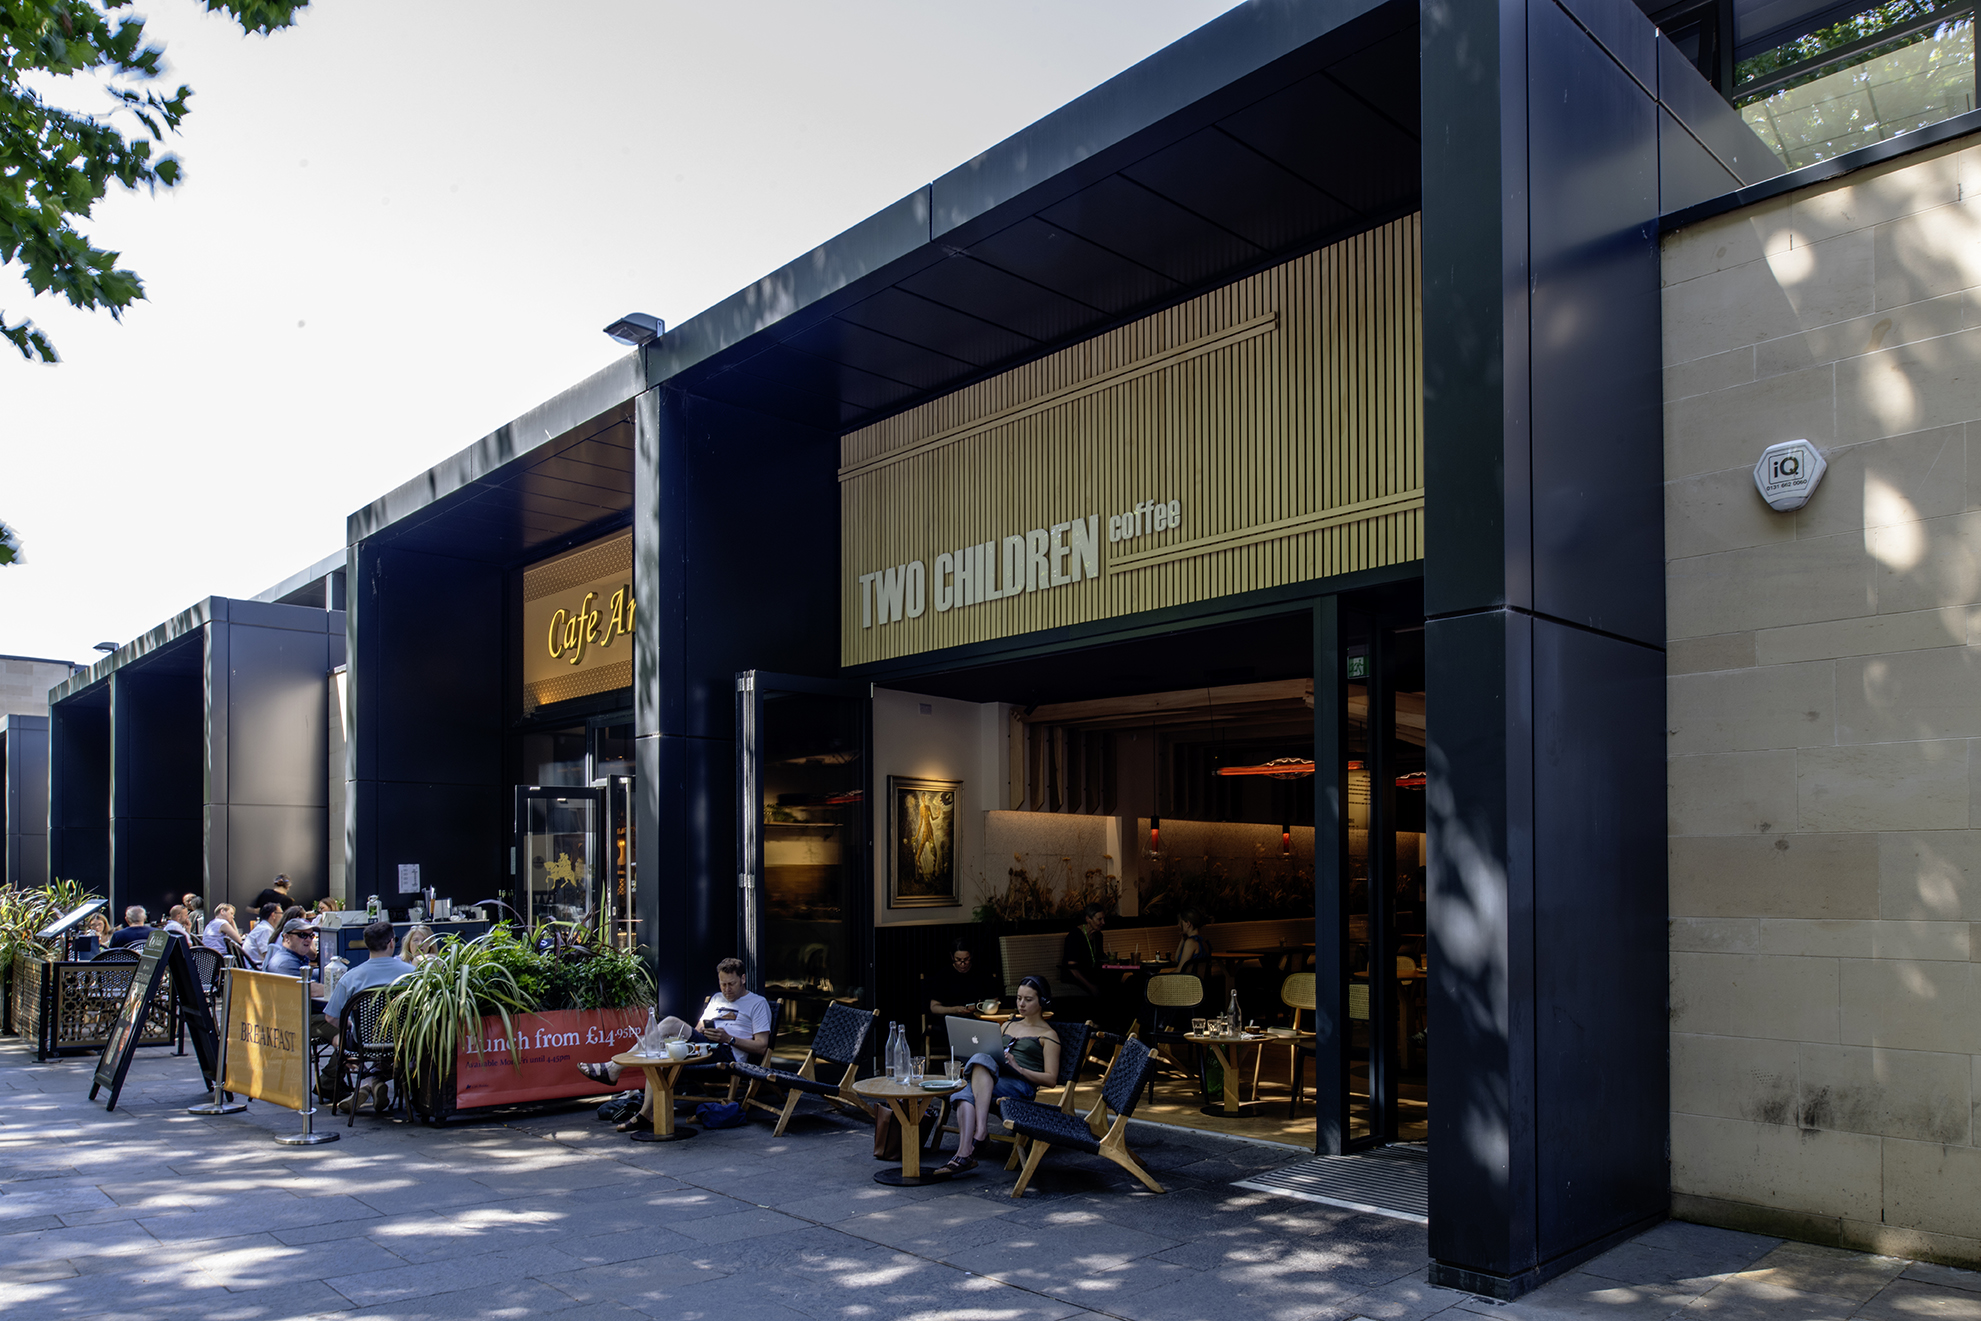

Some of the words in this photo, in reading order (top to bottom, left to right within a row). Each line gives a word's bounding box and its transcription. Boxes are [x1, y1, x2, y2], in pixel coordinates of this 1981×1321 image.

[1109, 499, 1181, 543] coffee
[859, 560, 926, 628] TWO
[933, 514, 1099, 612] CHILDREN
[548, 591, 602, 665] Cafe
[240, 1021, 296, 1052] BREAKFAST
[534, 1028, 580, 1049] from
[529, 1054, 545, 1063] until
